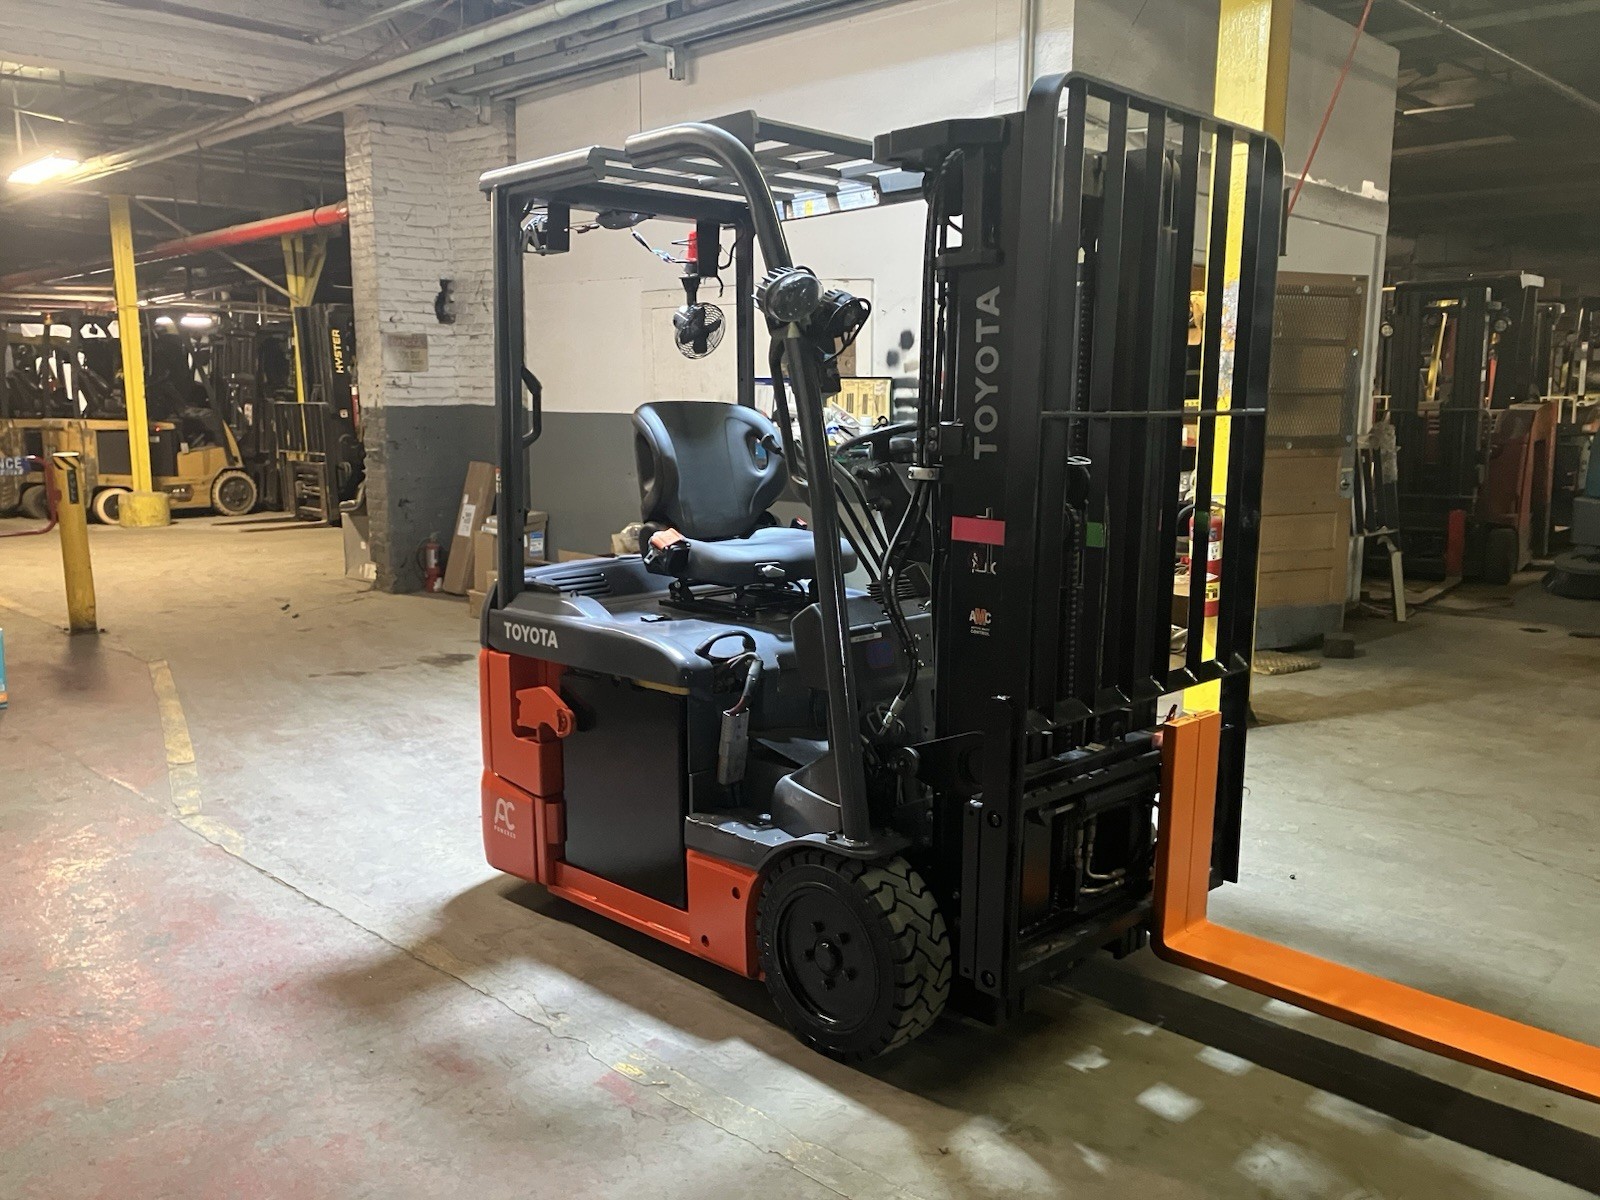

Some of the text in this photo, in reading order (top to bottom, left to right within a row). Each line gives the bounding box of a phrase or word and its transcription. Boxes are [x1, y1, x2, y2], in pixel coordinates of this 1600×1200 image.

[332, 330, 345, 374] HYSTER
[974, 285, 1000, 460] TOYOTA
[969, 607, 992, 626] AMC
[503, 621, 559, 649] TOYOTA
[494, 797, 515, 831] AC
